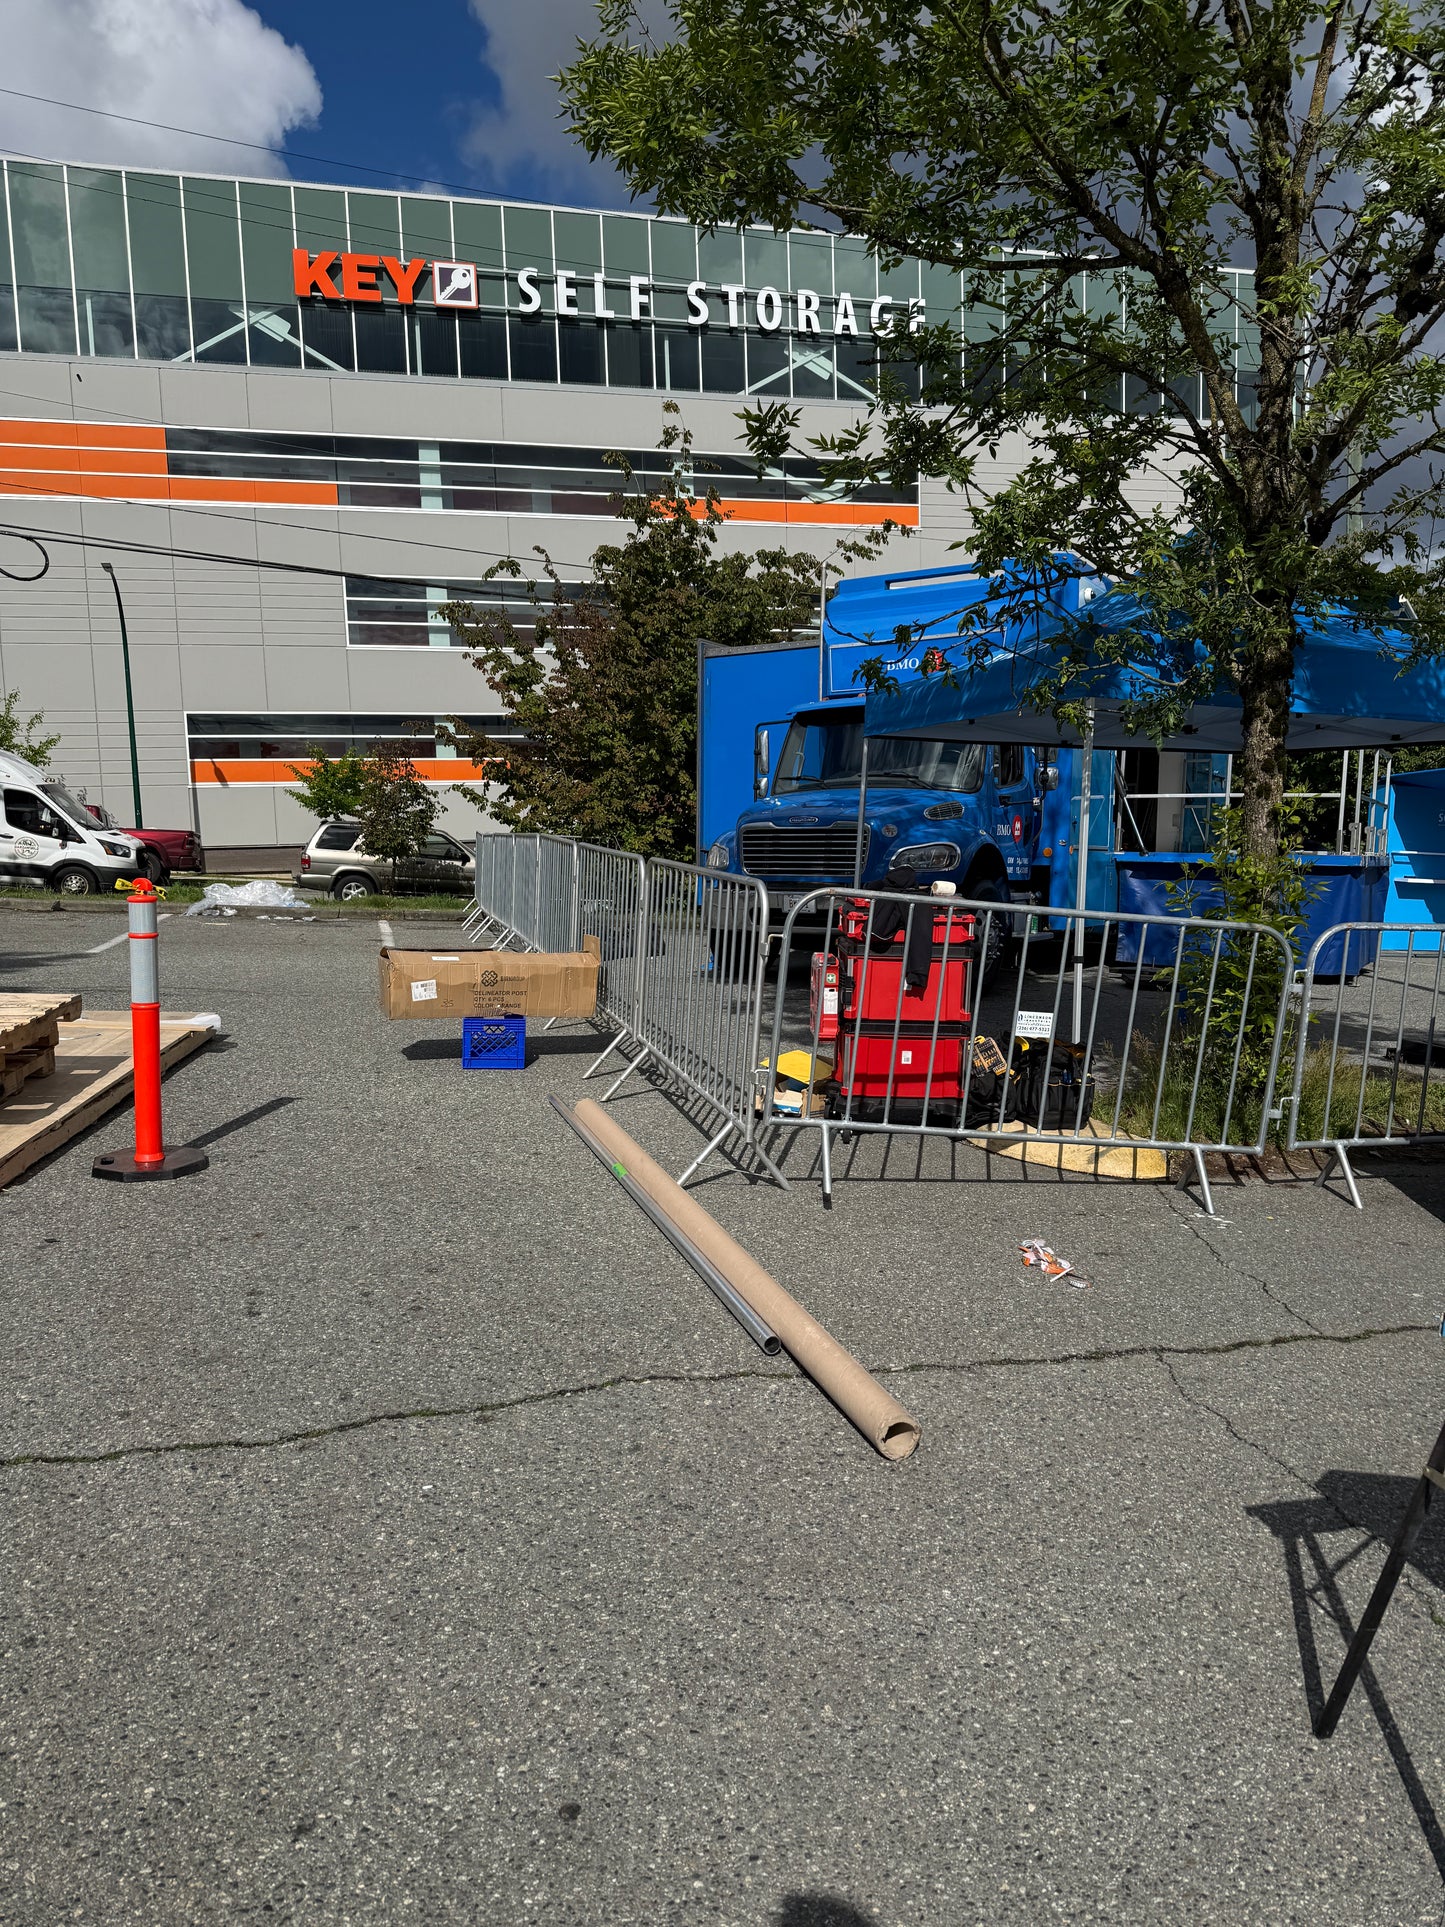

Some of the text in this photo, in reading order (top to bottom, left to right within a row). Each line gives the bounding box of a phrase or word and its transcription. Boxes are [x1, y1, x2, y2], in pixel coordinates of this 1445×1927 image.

[292, 249, 927, 339] KEY SELF STORAGE
[887, 657, 920, 671] BMO
[997, 824, 1012, 836] BMO
